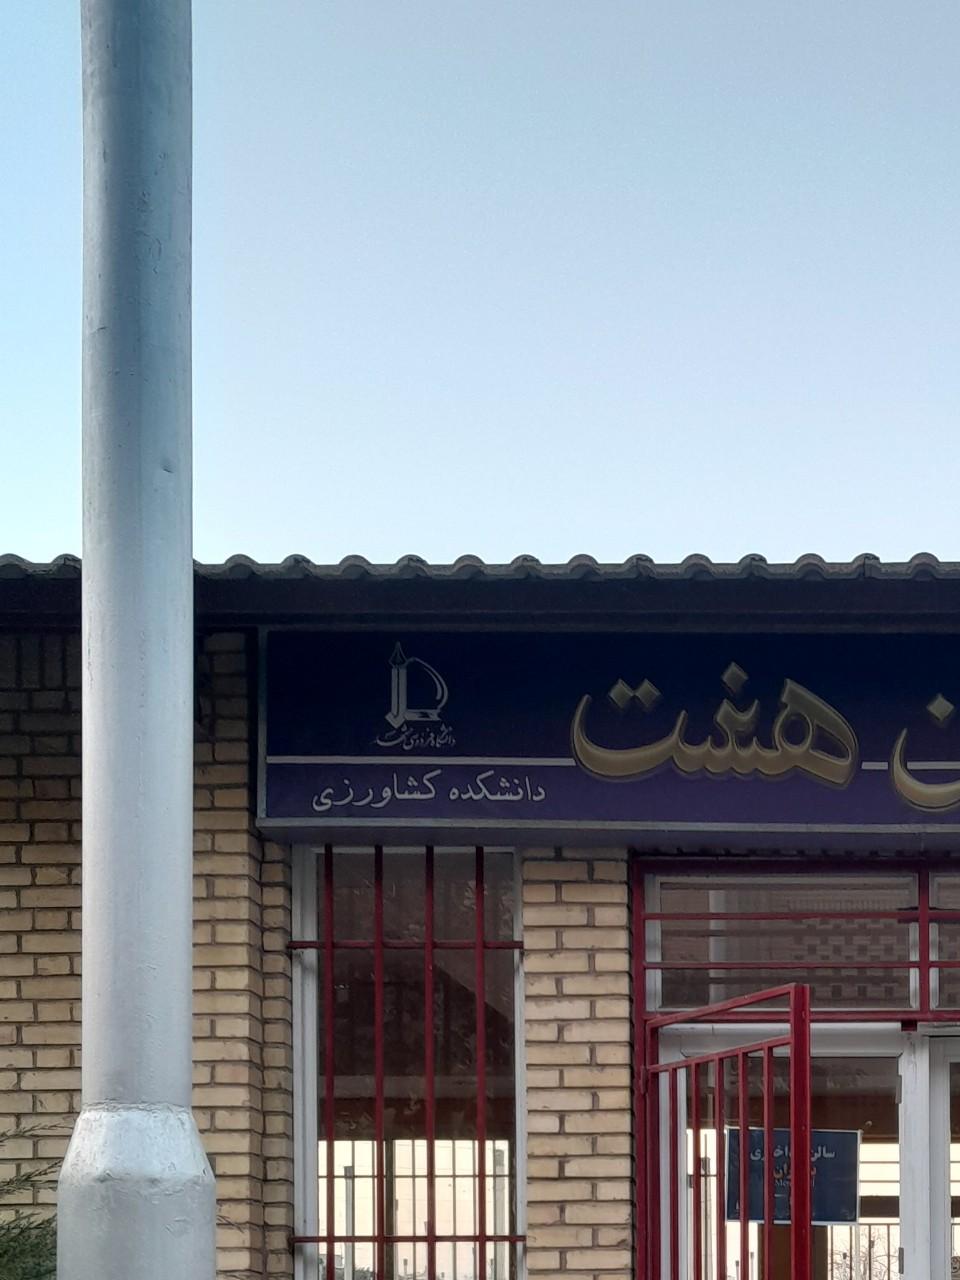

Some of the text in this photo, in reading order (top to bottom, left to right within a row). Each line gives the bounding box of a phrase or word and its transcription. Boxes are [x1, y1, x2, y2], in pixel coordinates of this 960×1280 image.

[570, 660, 860, 789] هشت
[312, 768, 546, 811] دانشکده کشاورزی
